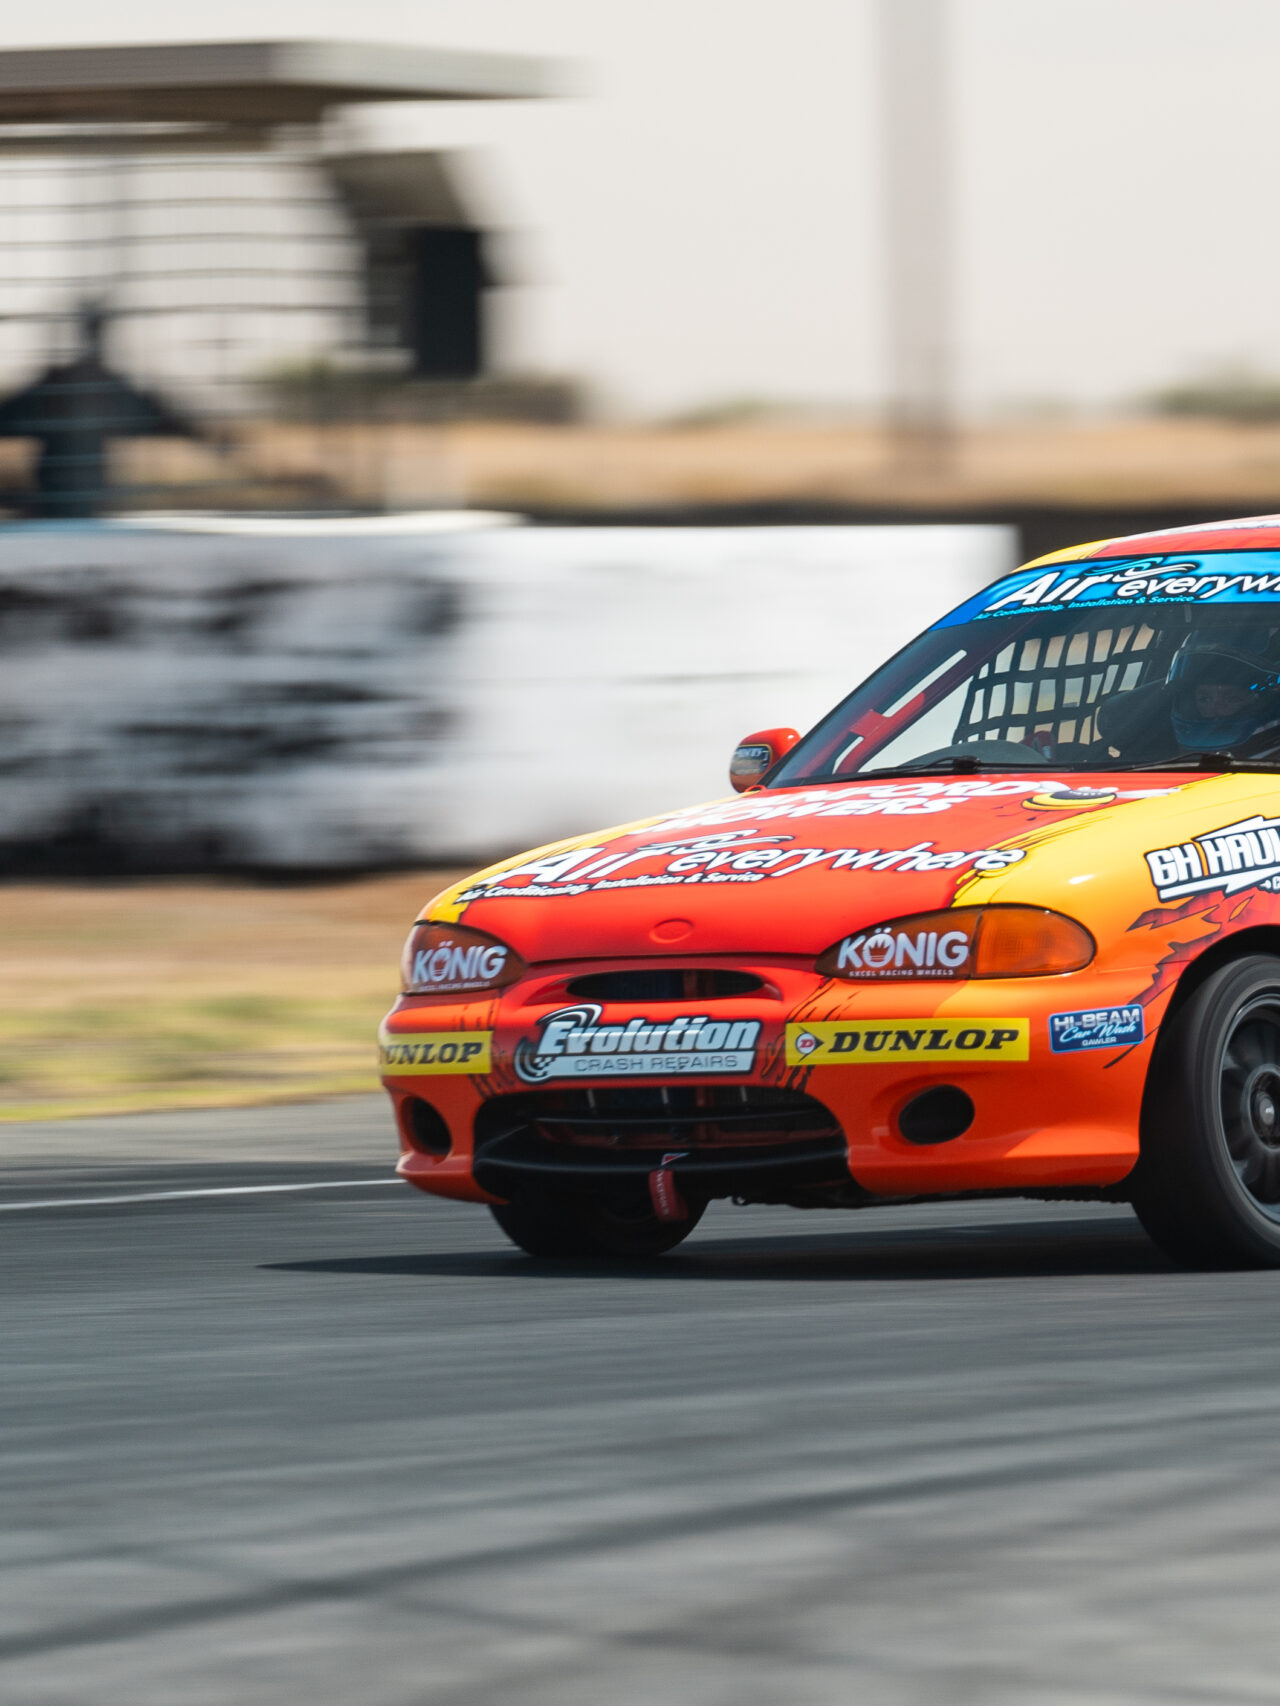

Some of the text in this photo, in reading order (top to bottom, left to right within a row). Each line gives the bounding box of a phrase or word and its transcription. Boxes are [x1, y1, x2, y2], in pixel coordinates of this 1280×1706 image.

[985, 571, 1113, 611] Air
[1067, 597, 1133, 608] Installation
[1149, 595, 1195, 604] Service
[477, 842, 1026, 884] Air everywhere
[1147, 843, 1203, 887] GH
[592, 874, 687, 890] Installation
[688, 872, 702, 883] &
[703, 870, 766, 883] Service
[837, 927, 969, 969] KÖNIG
[411, 940, 508, 984] KÖNIG
[1054, 1008, 1140, 1031] HI-BEAM
[537, 1017, 761, 1055] Evolution
[828, 1029, 1020, 1053] DUNLOP
[1060, 1021, 1136, 1043] Car Wash
[1082, 1036, 1117, 1046] GAWLER
[574, 1055, 738, 1072] CRASH REPAIRS
